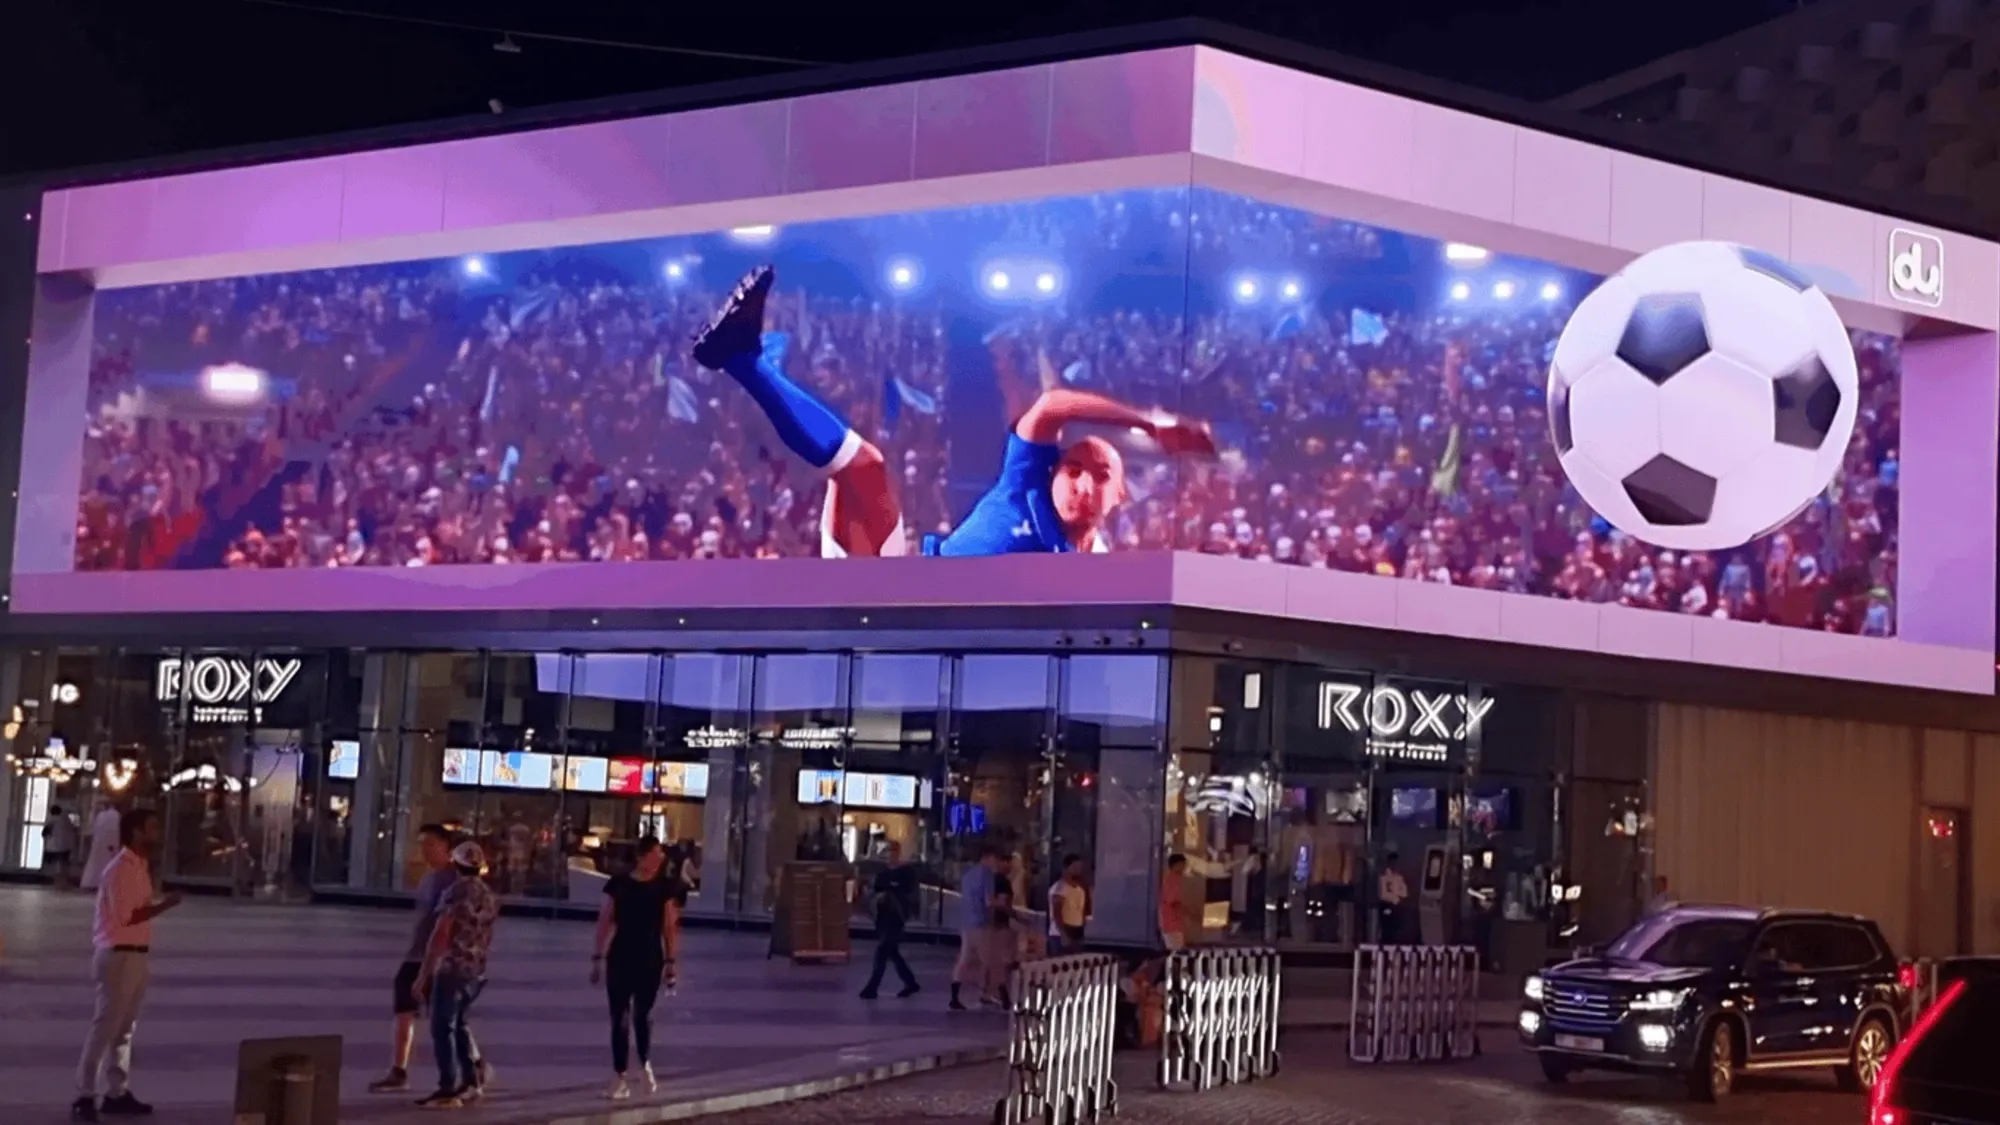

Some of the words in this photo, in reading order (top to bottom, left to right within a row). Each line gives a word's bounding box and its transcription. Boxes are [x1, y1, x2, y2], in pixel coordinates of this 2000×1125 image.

[1894, 242, 1940, 296] du
[157, 656, 302, 702] ROXY
[1318, 681, 1495, 740] ROXY
